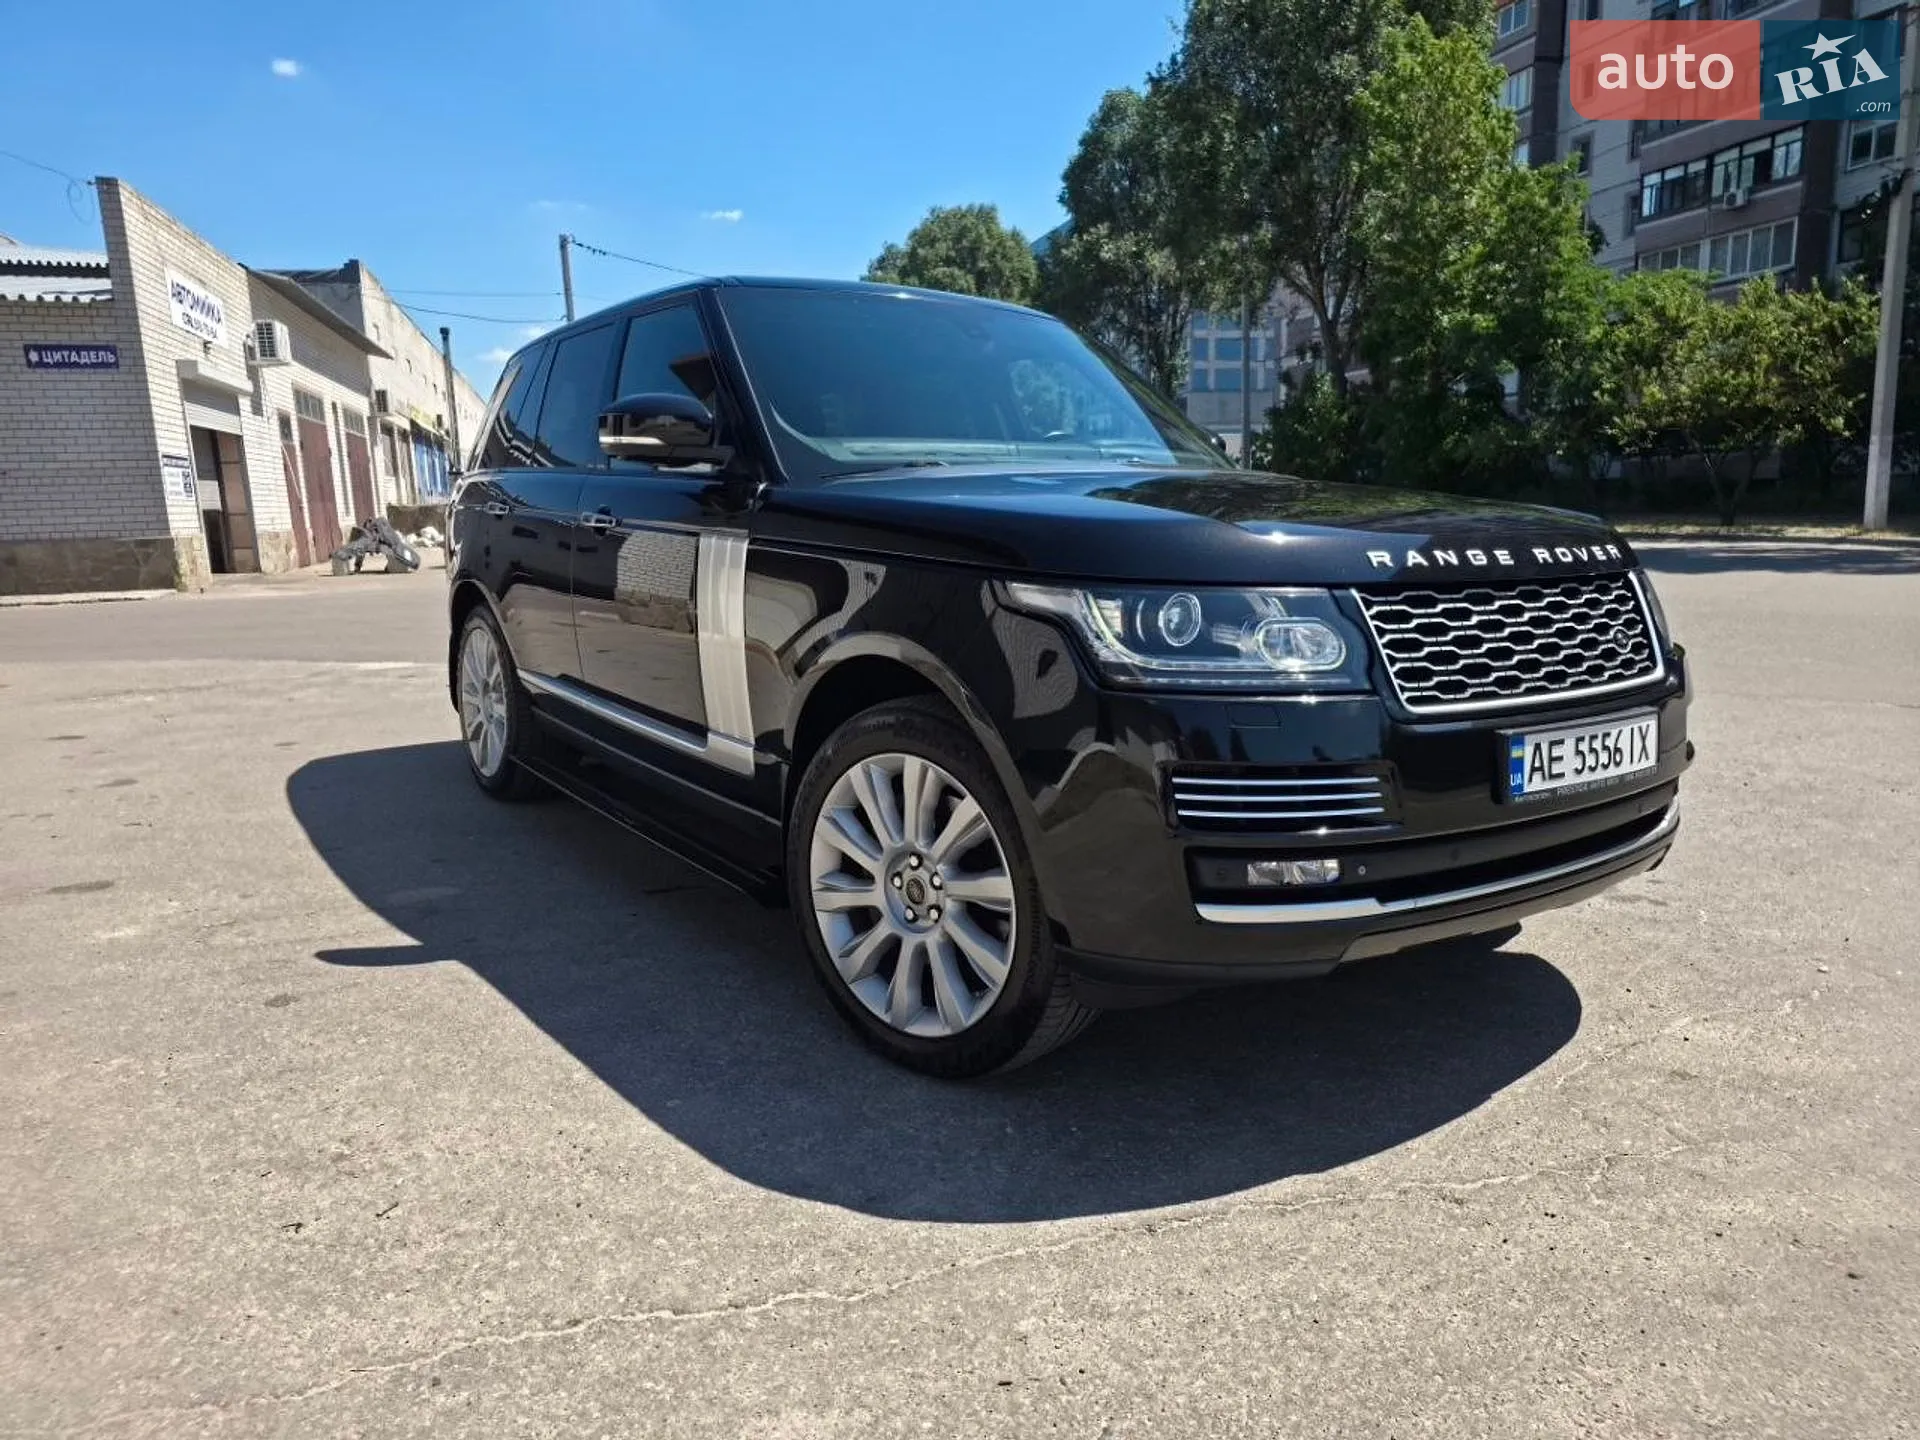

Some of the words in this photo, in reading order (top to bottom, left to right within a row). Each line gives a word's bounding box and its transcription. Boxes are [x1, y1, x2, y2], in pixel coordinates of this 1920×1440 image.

[171, 279, 222, 325] АВТОМИЙКА
[42, 350, 116, 365] ЦИТАДЕЛЬ
[1366, 549, 1514, 568] RANGE
[1532, 544, 1622, 564] ROVER
[1528, 738, 1566, 784] AE
[1573, 729, 1624, 775] 5556
[1629, 723, 1650, 765] IX
[1510, 773, 1522, 786] UA
